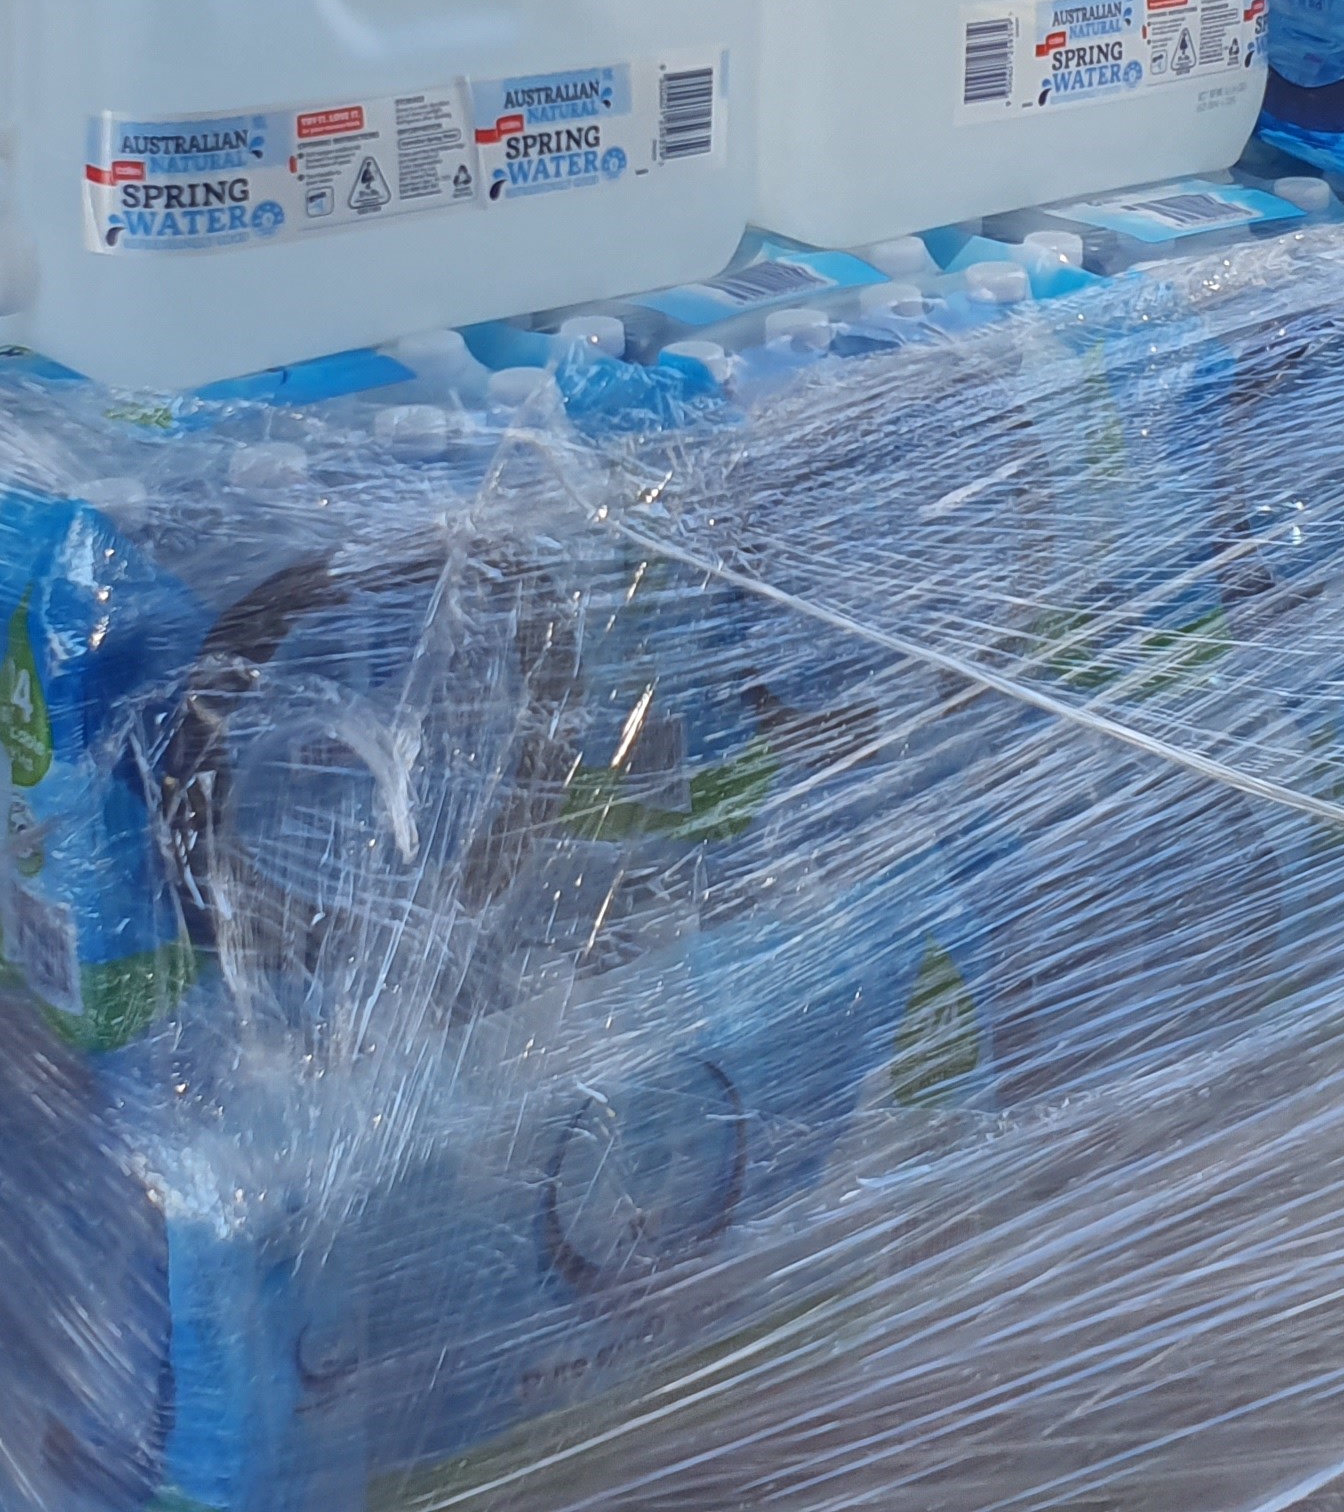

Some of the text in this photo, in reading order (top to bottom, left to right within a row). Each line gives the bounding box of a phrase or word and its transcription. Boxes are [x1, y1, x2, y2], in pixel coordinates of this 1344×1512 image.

[1052, 1, 1122, 27] AUSTRALIAN
[1069, 18, 1121, 39] NATURAL
[1052, 41, 1123, 71] SPRING
[1052, 63, 1121, 93] WATER
[504, 80, 599, 109] AUSTRALIAN
[527, 100, 598, 124] NATURAL
[121, 130, 249, 155] AUSTRALIAN
[506, 125, 600, 160] SPRING
[149, 151, 247, 173] NATURAL
[507, 150, 599, 185] WATER
[122, 178, 249, 209] SPRING
[123, 205, 248, 236] WATER
